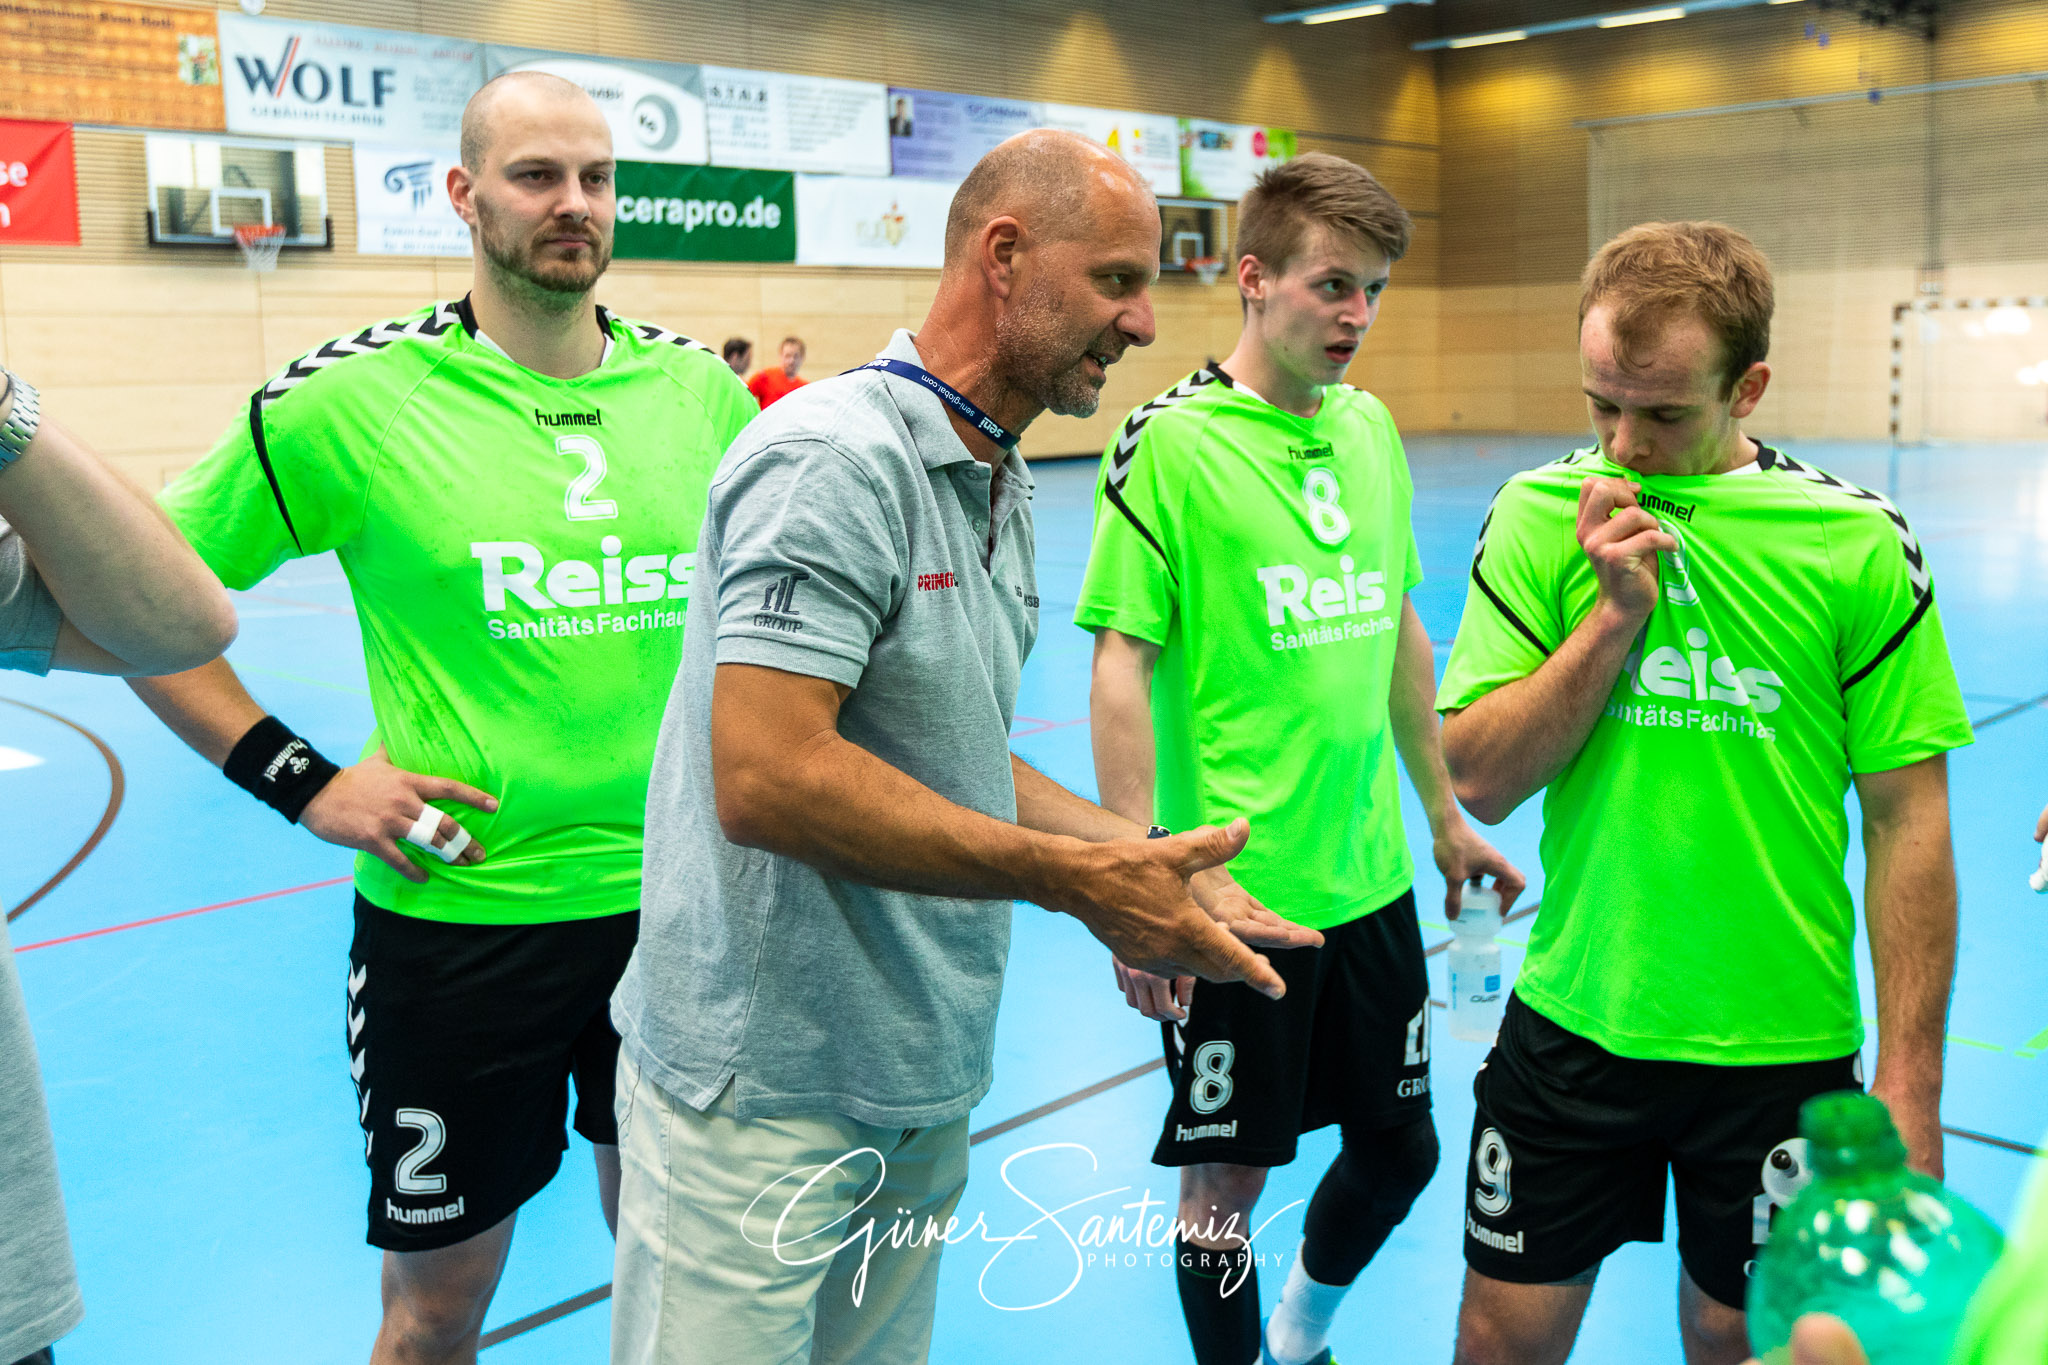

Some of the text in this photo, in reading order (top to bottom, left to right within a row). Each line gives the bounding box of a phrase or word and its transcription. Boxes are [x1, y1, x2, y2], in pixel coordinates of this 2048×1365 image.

[235, 36, 396, 108] WOLF
[616, 195, 781, 233] cerapro.de
[535, 408, 602, 426] hummel
[921, 374, 976, 417] seni-global.com
[978, 417, 1004, 439] seni
[1288, 442, 1334, 460] hummel
[555, 434, 619, 522] 2
[1302, 467, 1351, 545] 8
[1638, 493, 1696, 523] ummel
[470, 535, 697, 611] Reiss
[1257, 554, 1386, 627] Reis
[753, 614, 803, 633] GROUP
[1617, 627, 1785, 714] eiss
[264, 738, 309, 783] hummel
[1190, 1040, 1235, 1115] 8
[1396, 1073, 1431, 1098] GRO
[395, 1107, 447, 1195] 2
[1175, 1119, 1238, 1142] hummel
[1474, 1127, 1512, 1217] 9
[386, 1195, 465, 1224] hummel
[1465, 1208, 1524, 1254] hummel
